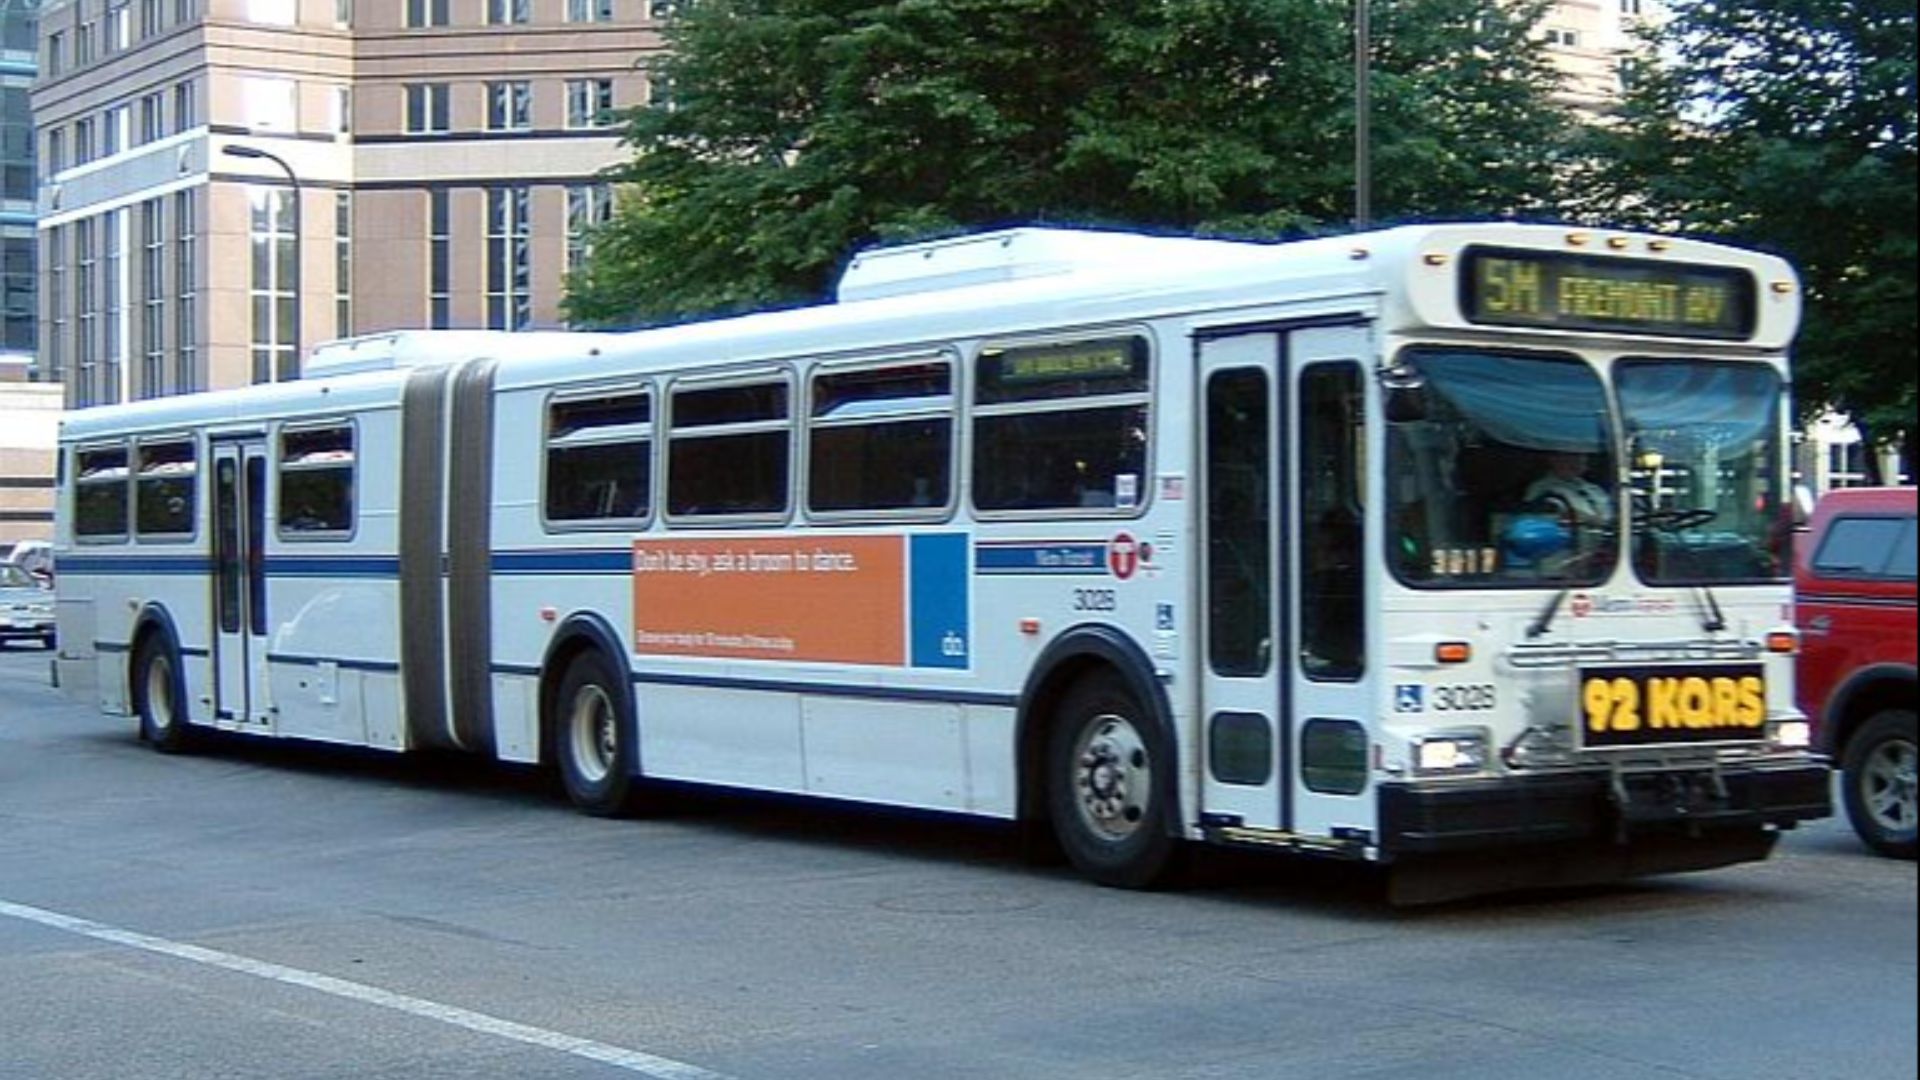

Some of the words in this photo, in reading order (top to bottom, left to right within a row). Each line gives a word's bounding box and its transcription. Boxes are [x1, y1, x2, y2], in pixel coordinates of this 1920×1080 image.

[1557, 276, 1677, 321] FREMONT
[637, 550, 666, 571] Don't
[667, 550, 683, 571] be
[712, 550, 735, 571] ask
[736, 554, 747, 571] a
[748, 550, 793, 571] broom
[794, 550, 810, 571] to
[812, 548, 859, 571] dance.
[1433, 684, 1494, 711] 3028
[1585, 678, 1640, 732] 92
[1647, 677, 1766, 728] KQRS
